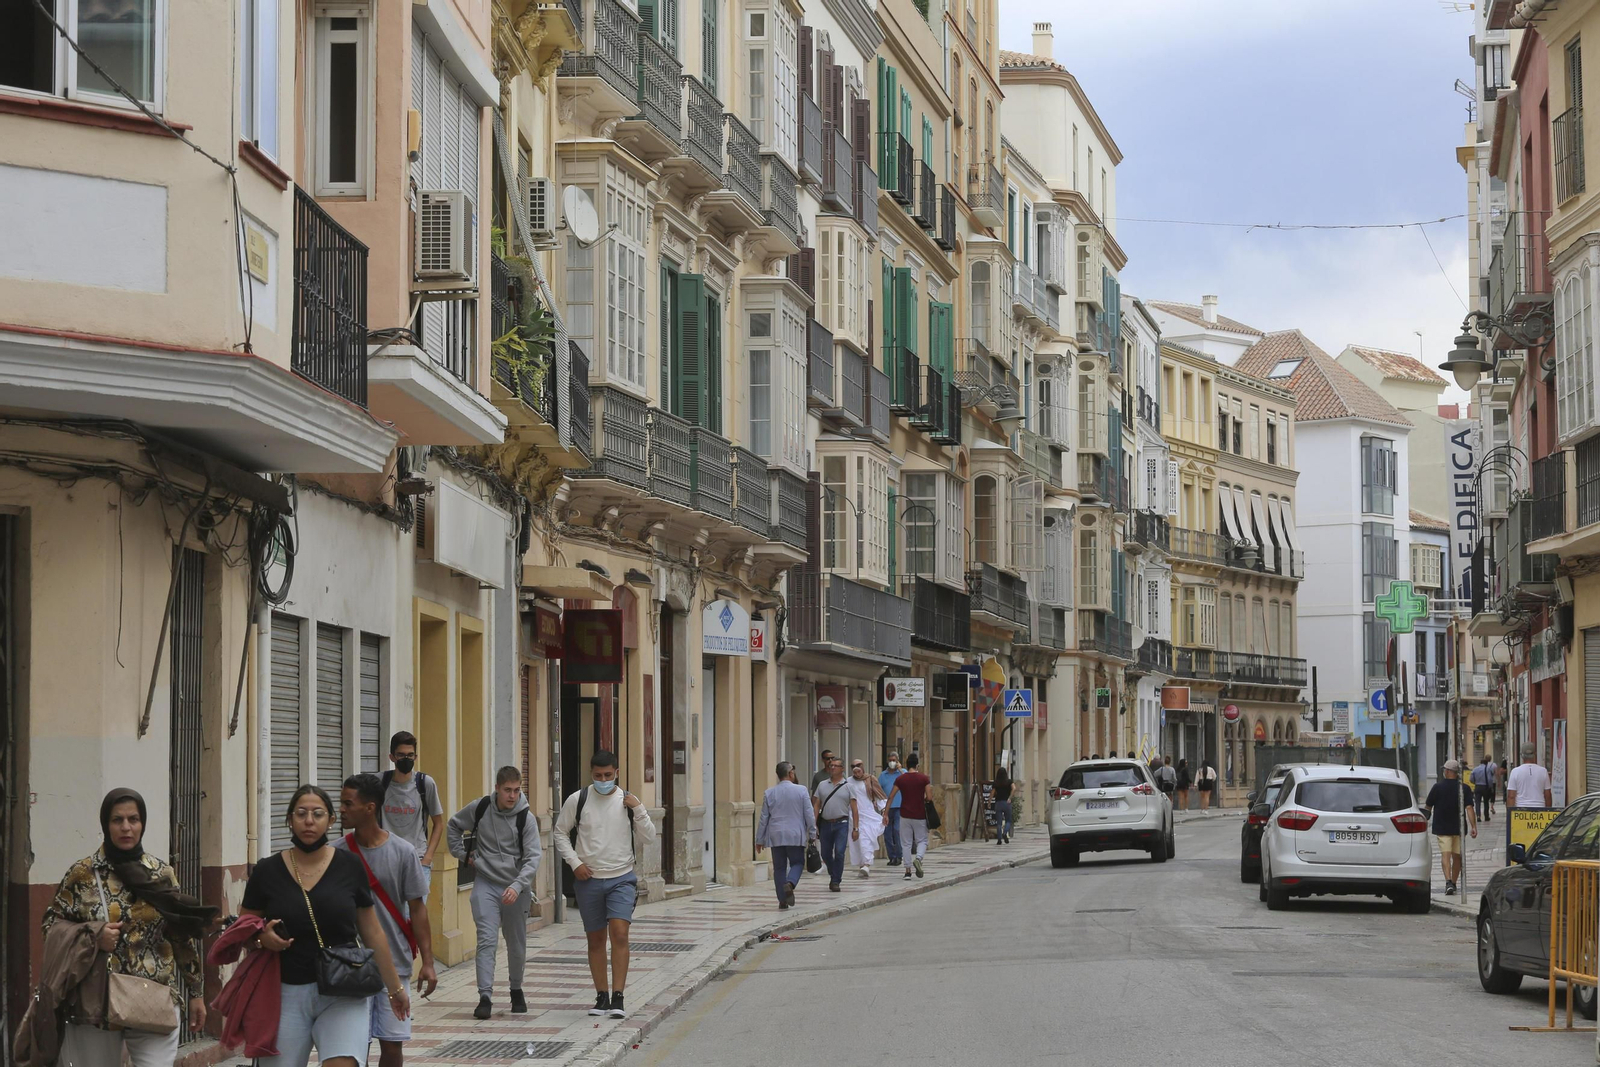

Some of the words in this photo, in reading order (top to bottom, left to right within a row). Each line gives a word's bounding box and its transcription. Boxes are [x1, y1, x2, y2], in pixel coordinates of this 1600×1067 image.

[1514, 812, 1544, 821] POLICIA
[1526, 822, 1549, 830] MALA
[1335, 831, 1358, 841] 8059
[1360, 832, 1377, 841] HSX
